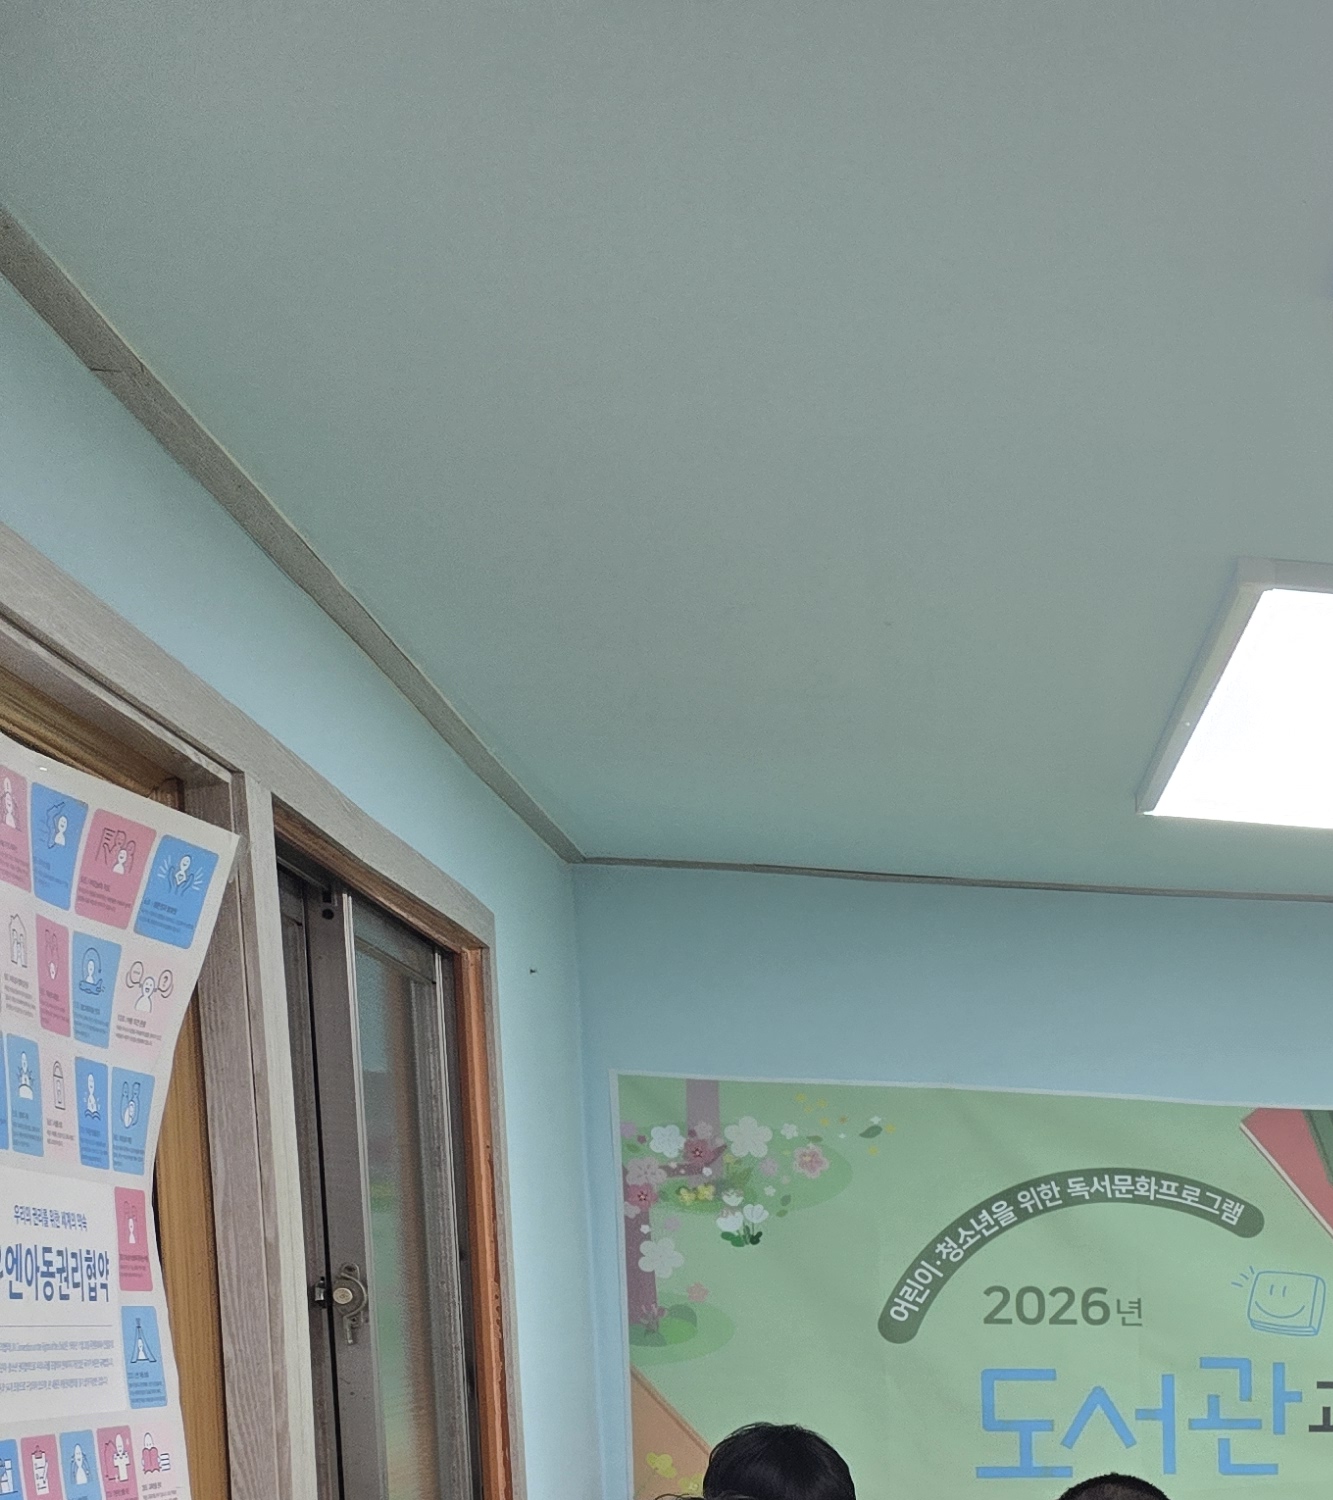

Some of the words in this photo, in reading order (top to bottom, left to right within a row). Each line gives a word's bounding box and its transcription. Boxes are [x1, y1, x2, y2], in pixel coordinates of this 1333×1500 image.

[0, 1242, 110, 1303] 엔아동권리협약
[889, 1198, 1017, 1323] 어린이·청소년을
[1016, 1181, 1064, 1214] 위한
[1066, 1174, 1246, 1226] 독서문화프로그램
[982, 1284, 1144, 1328] 2026년
